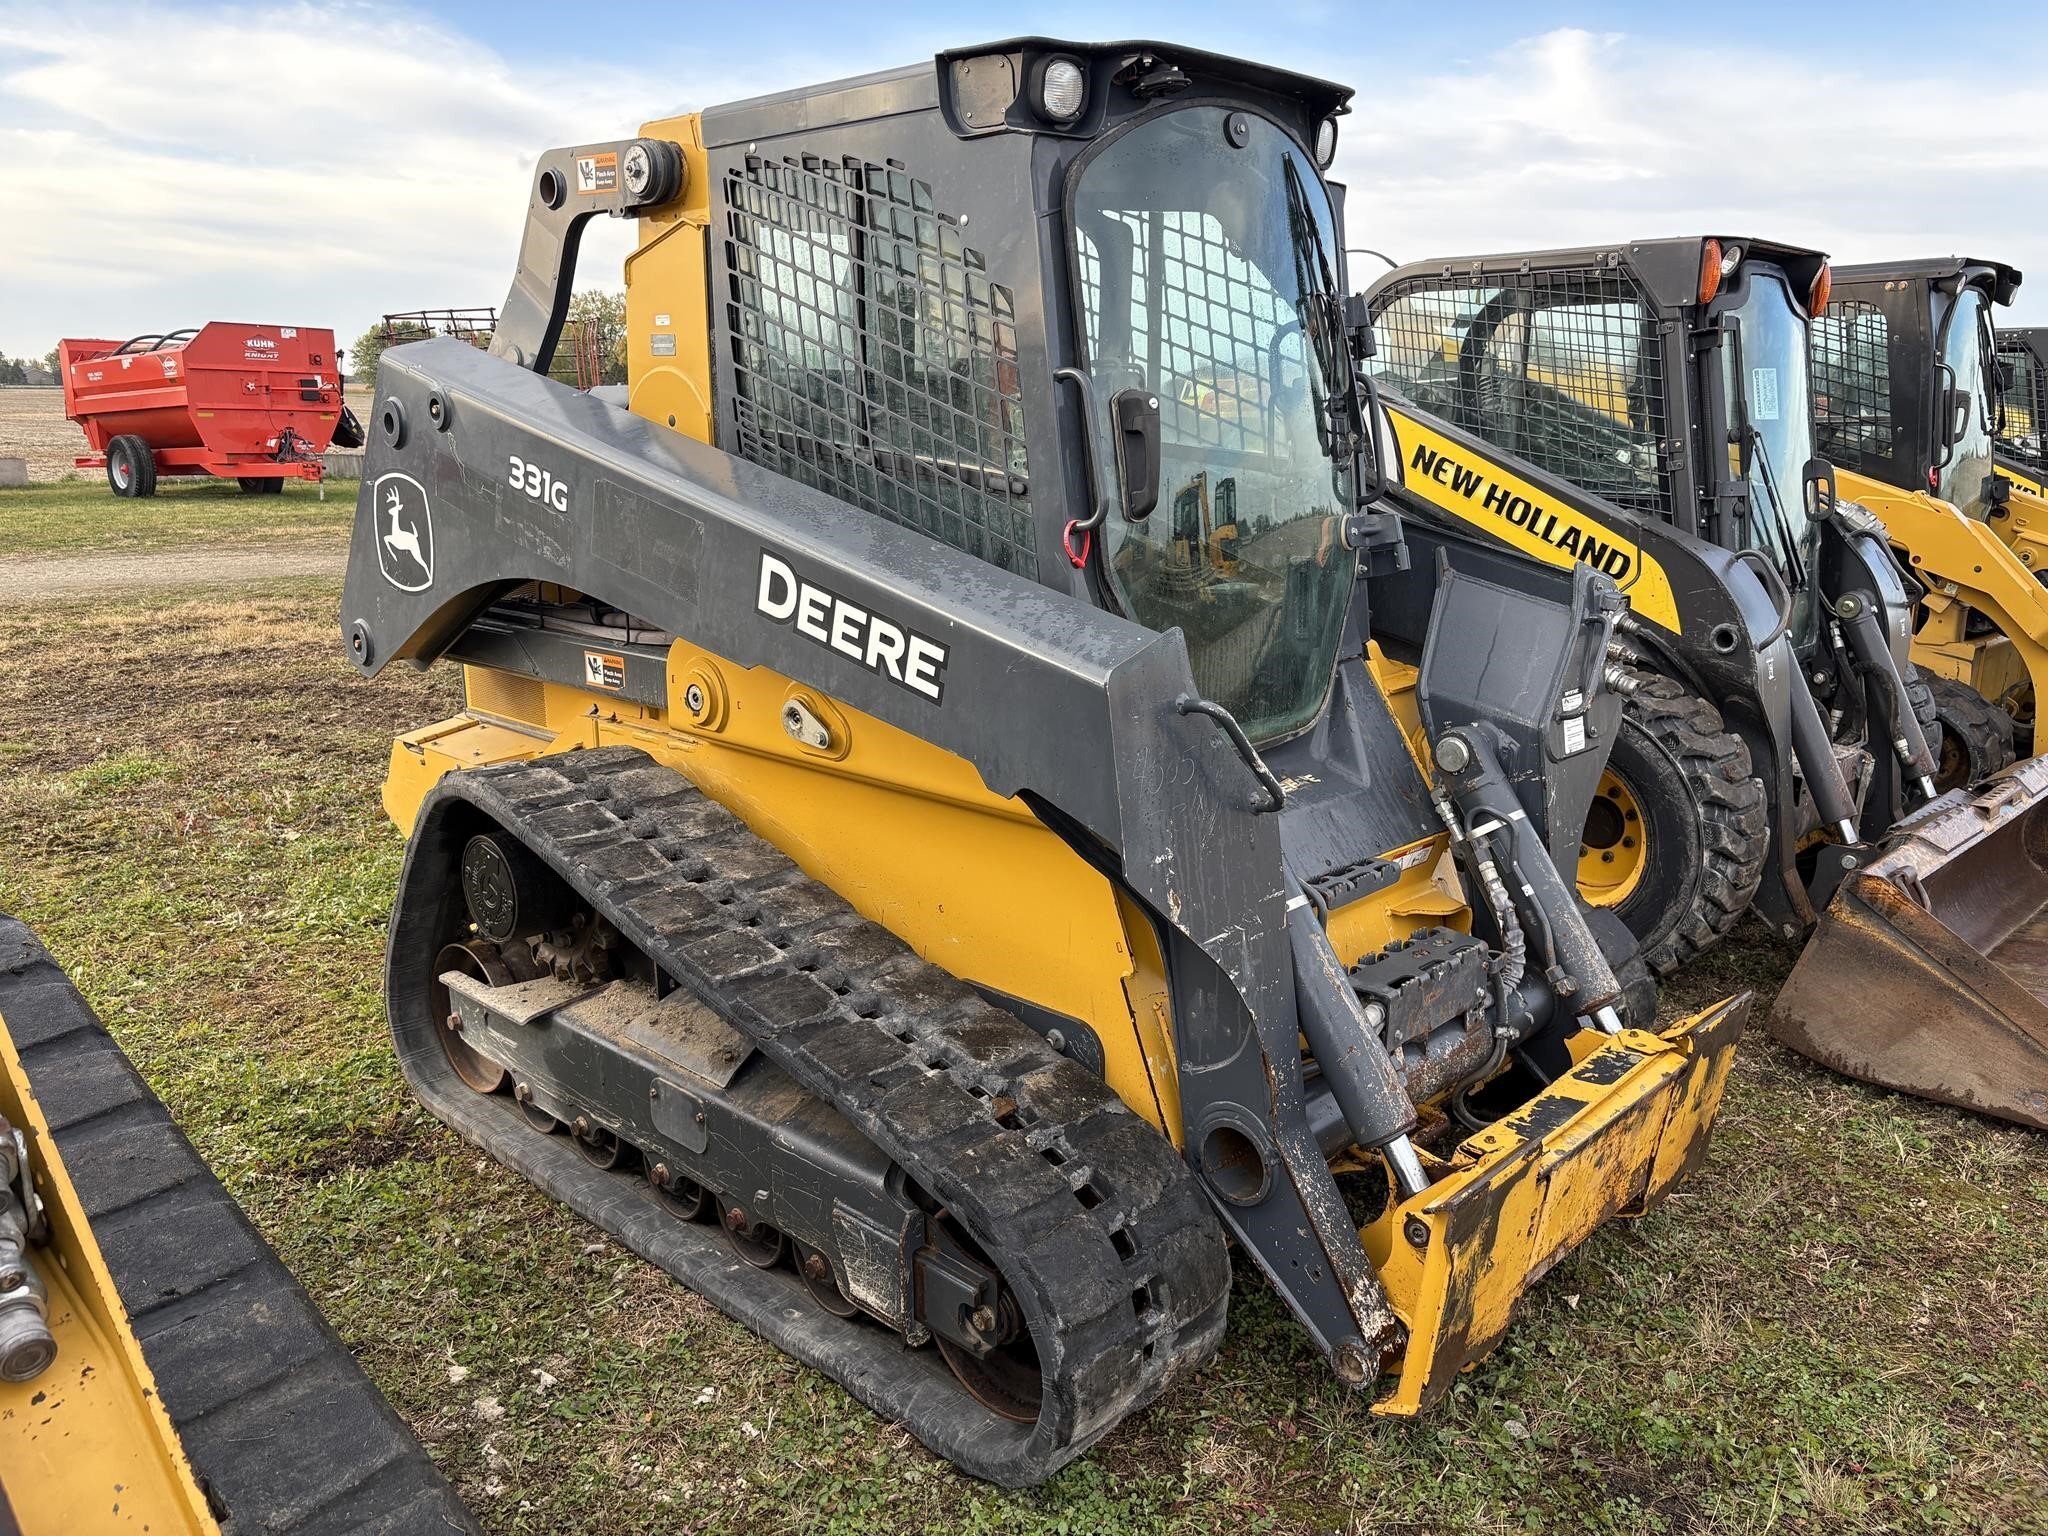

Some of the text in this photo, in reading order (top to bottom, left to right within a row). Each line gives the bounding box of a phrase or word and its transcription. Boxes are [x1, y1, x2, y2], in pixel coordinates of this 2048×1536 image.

[246, 339, 275, 348] KUHN
[508, 455, 568, 512] 331G
[1411, 444, 1631, 580] NEW HOLLAND
[757, 553, 946, 699] DEERE
